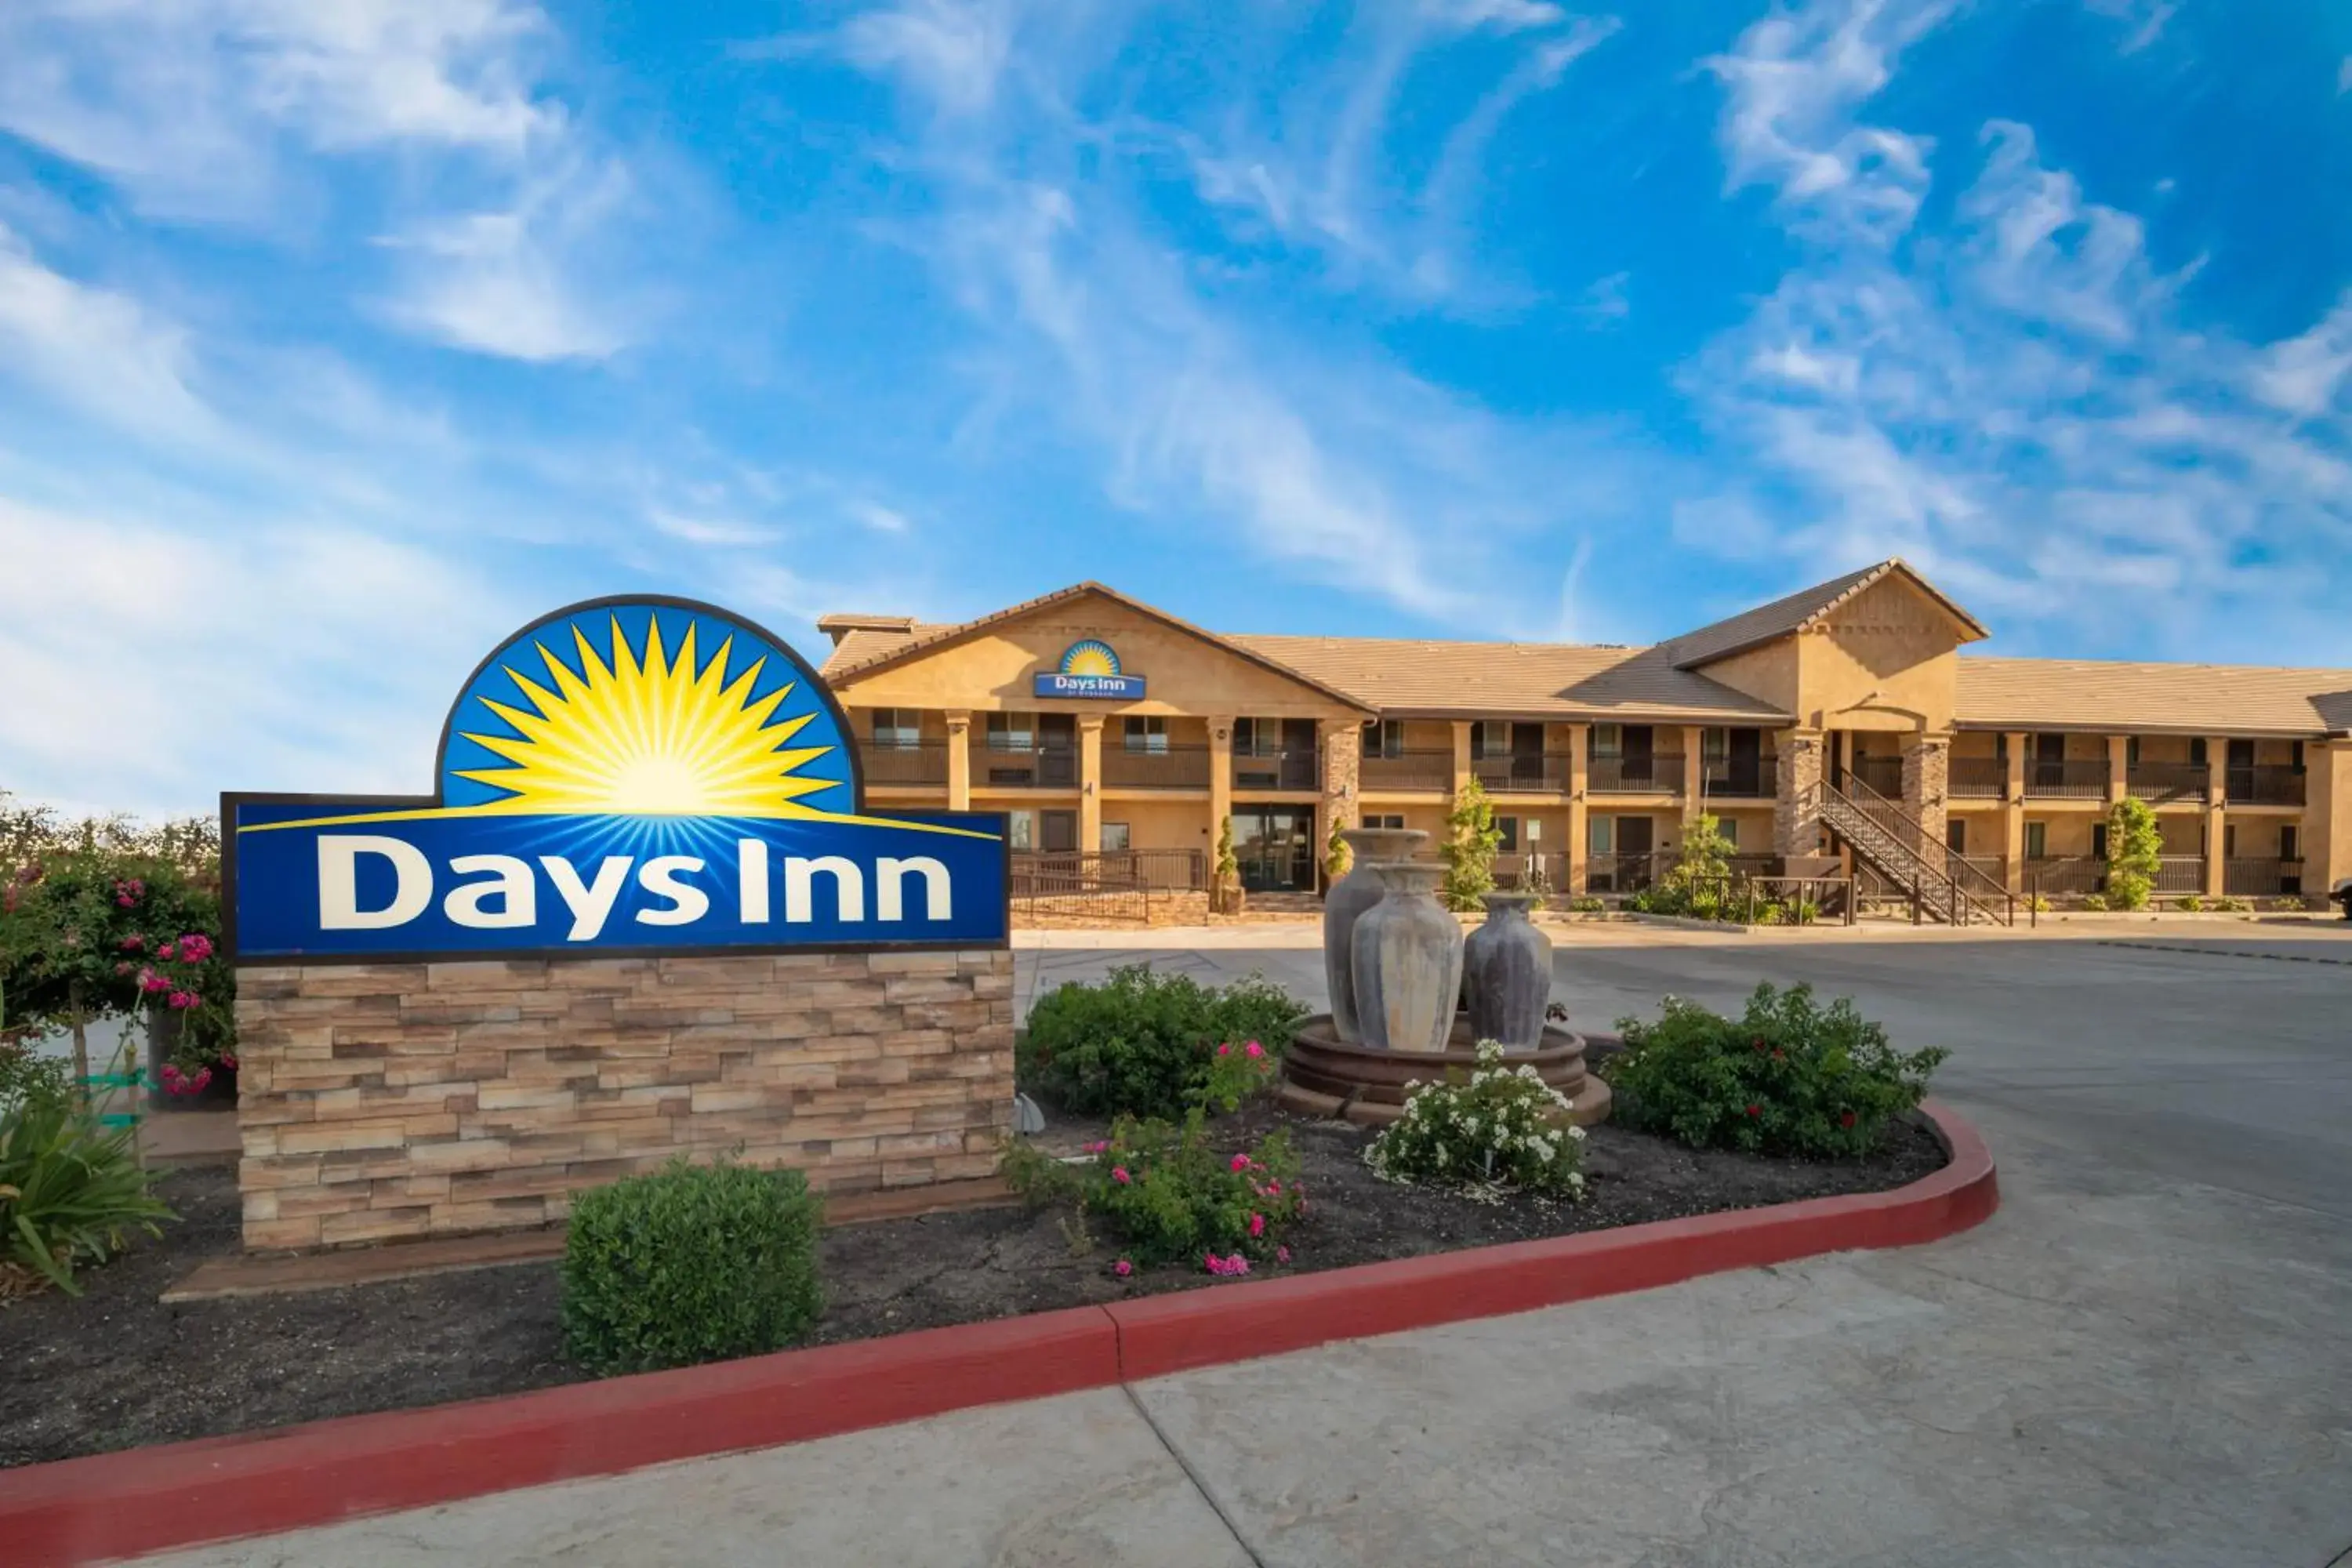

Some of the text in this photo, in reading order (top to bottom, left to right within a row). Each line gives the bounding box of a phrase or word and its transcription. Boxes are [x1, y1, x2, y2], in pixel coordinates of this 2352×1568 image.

[1055, 677, 1126, 691] Days Inn
[317, 835, 952, 942] Days Inn
